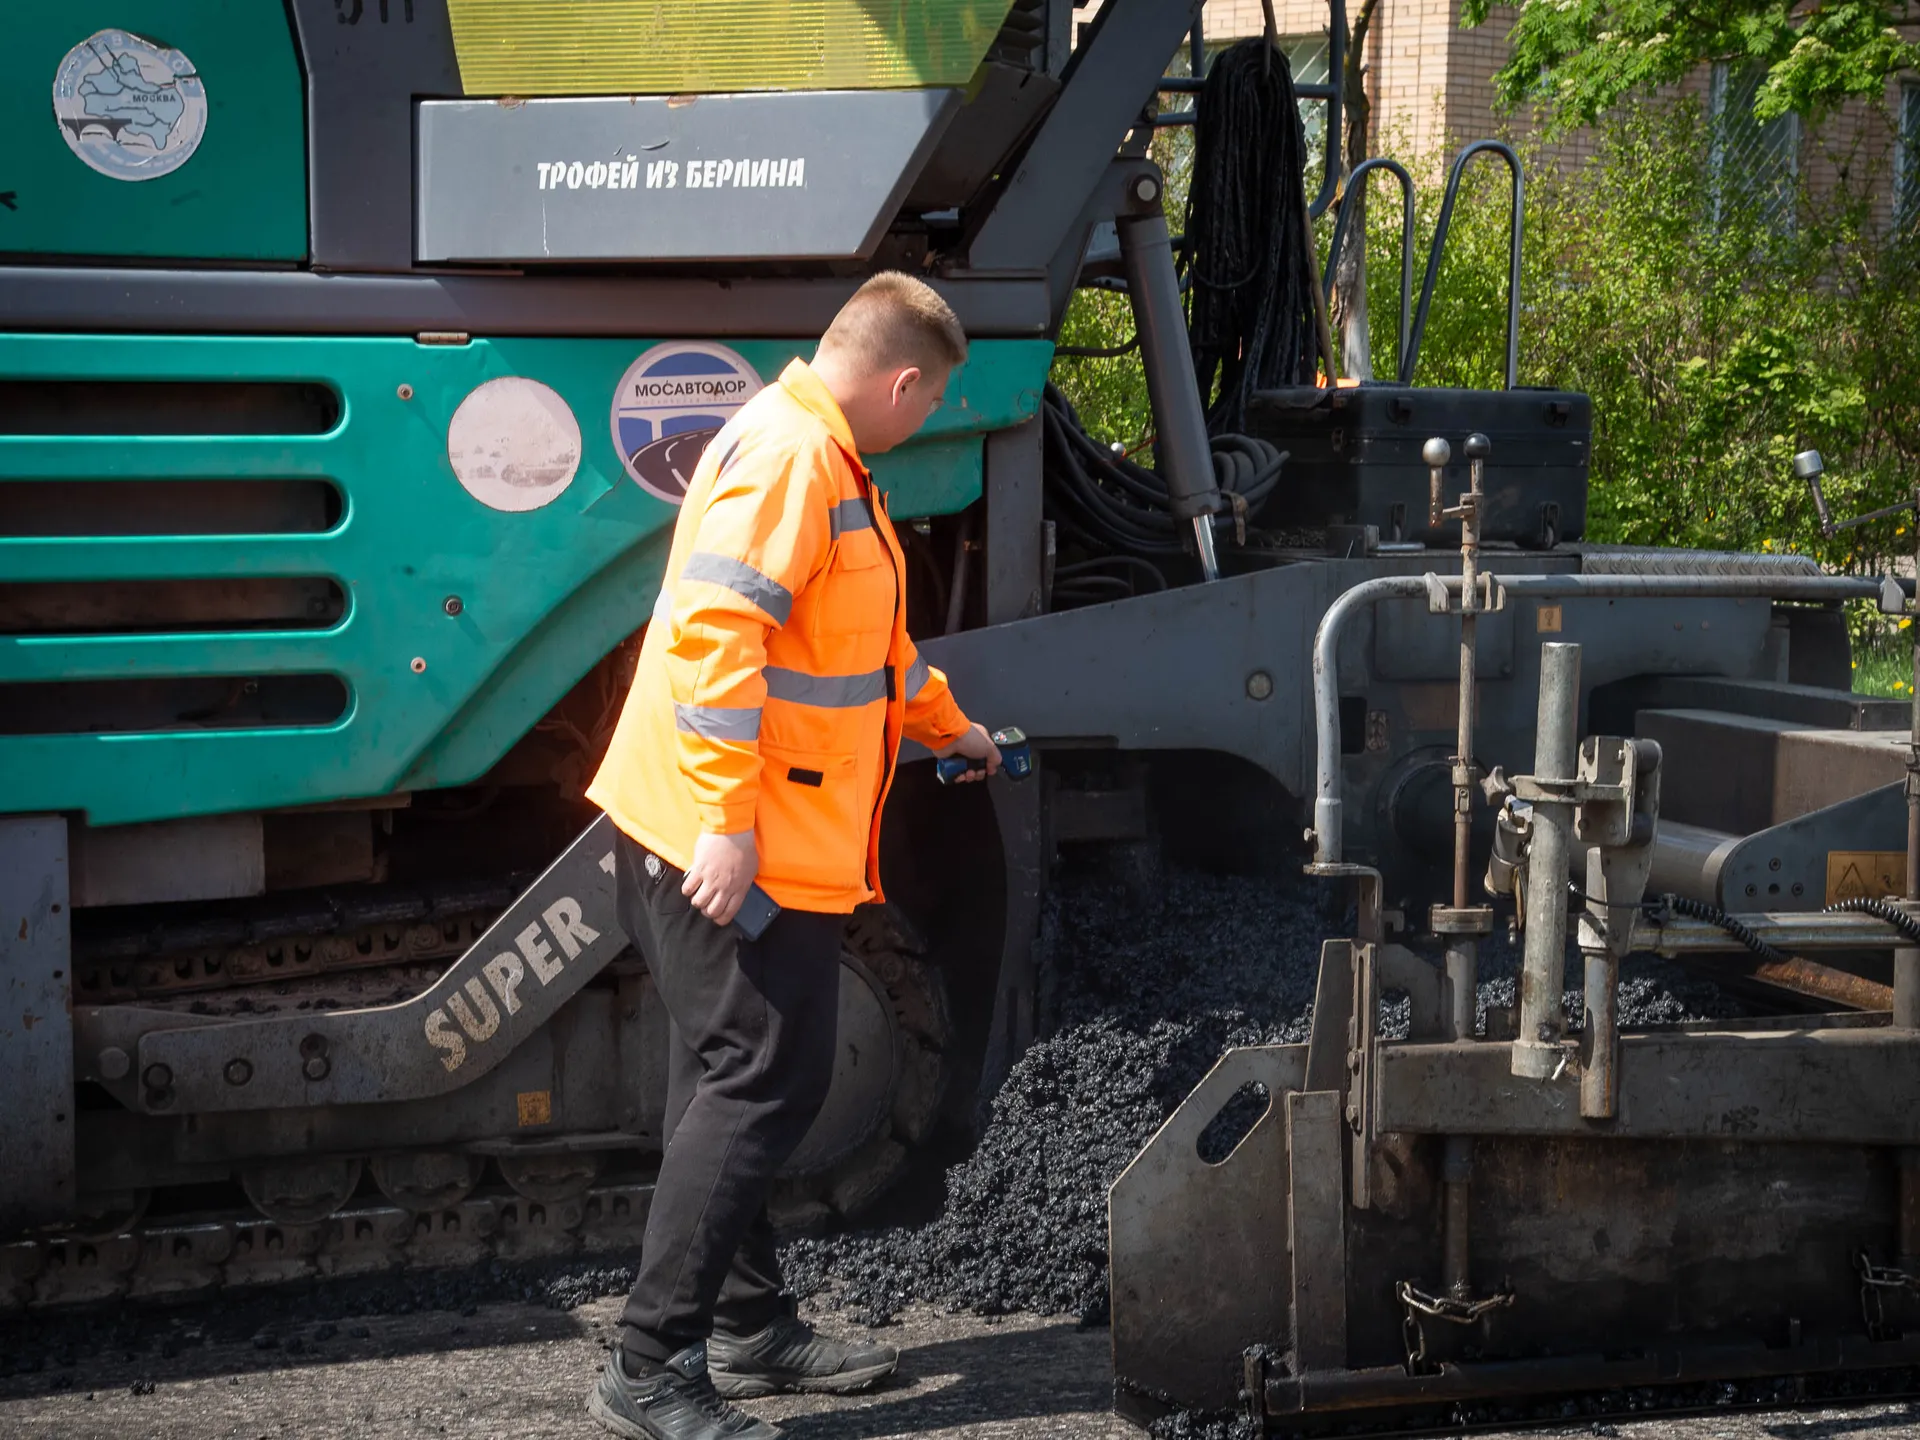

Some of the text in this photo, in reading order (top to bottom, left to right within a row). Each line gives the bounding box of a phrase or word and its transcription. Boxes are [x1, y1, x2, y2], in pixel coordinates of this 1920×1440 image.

[132, 94, 176, 103] МОСКВА
[537, 154, 805, 190] ТРОФЕЙ ИЗ БЕРЛИНА
[635, 380, 747, 397] МОСАВТОДОР
[424, 896, 600, 1072] SUPER
